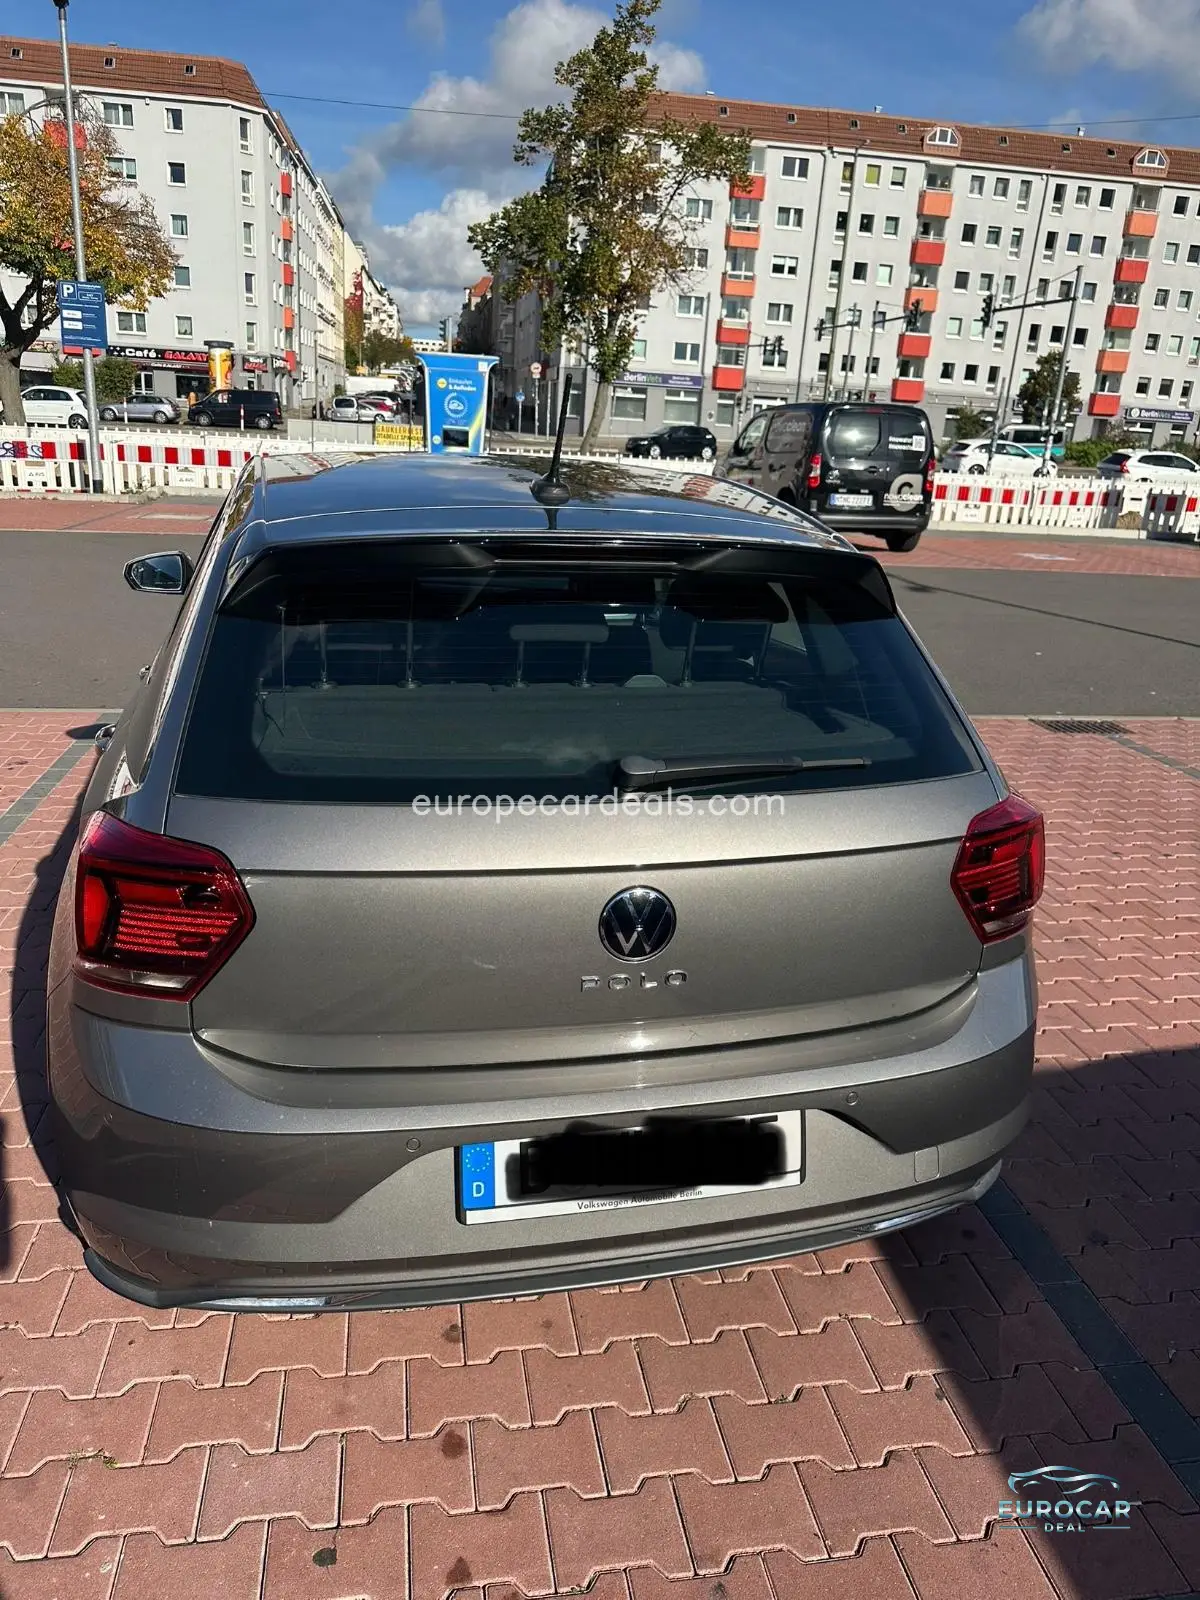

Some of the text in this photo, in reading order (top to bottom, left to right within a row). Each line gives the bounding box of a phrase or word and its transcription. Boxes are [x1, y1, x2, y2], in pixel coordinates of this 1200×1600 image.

[62, 284, 74, 297] P
[125, 348, 208, 361] Café GALAXY
[580, 969, 688, 992] POLO
[472, 1181, 485, 1197] D
[577, 1188, 703, 1210] Volkswagen Automobile Berlin
